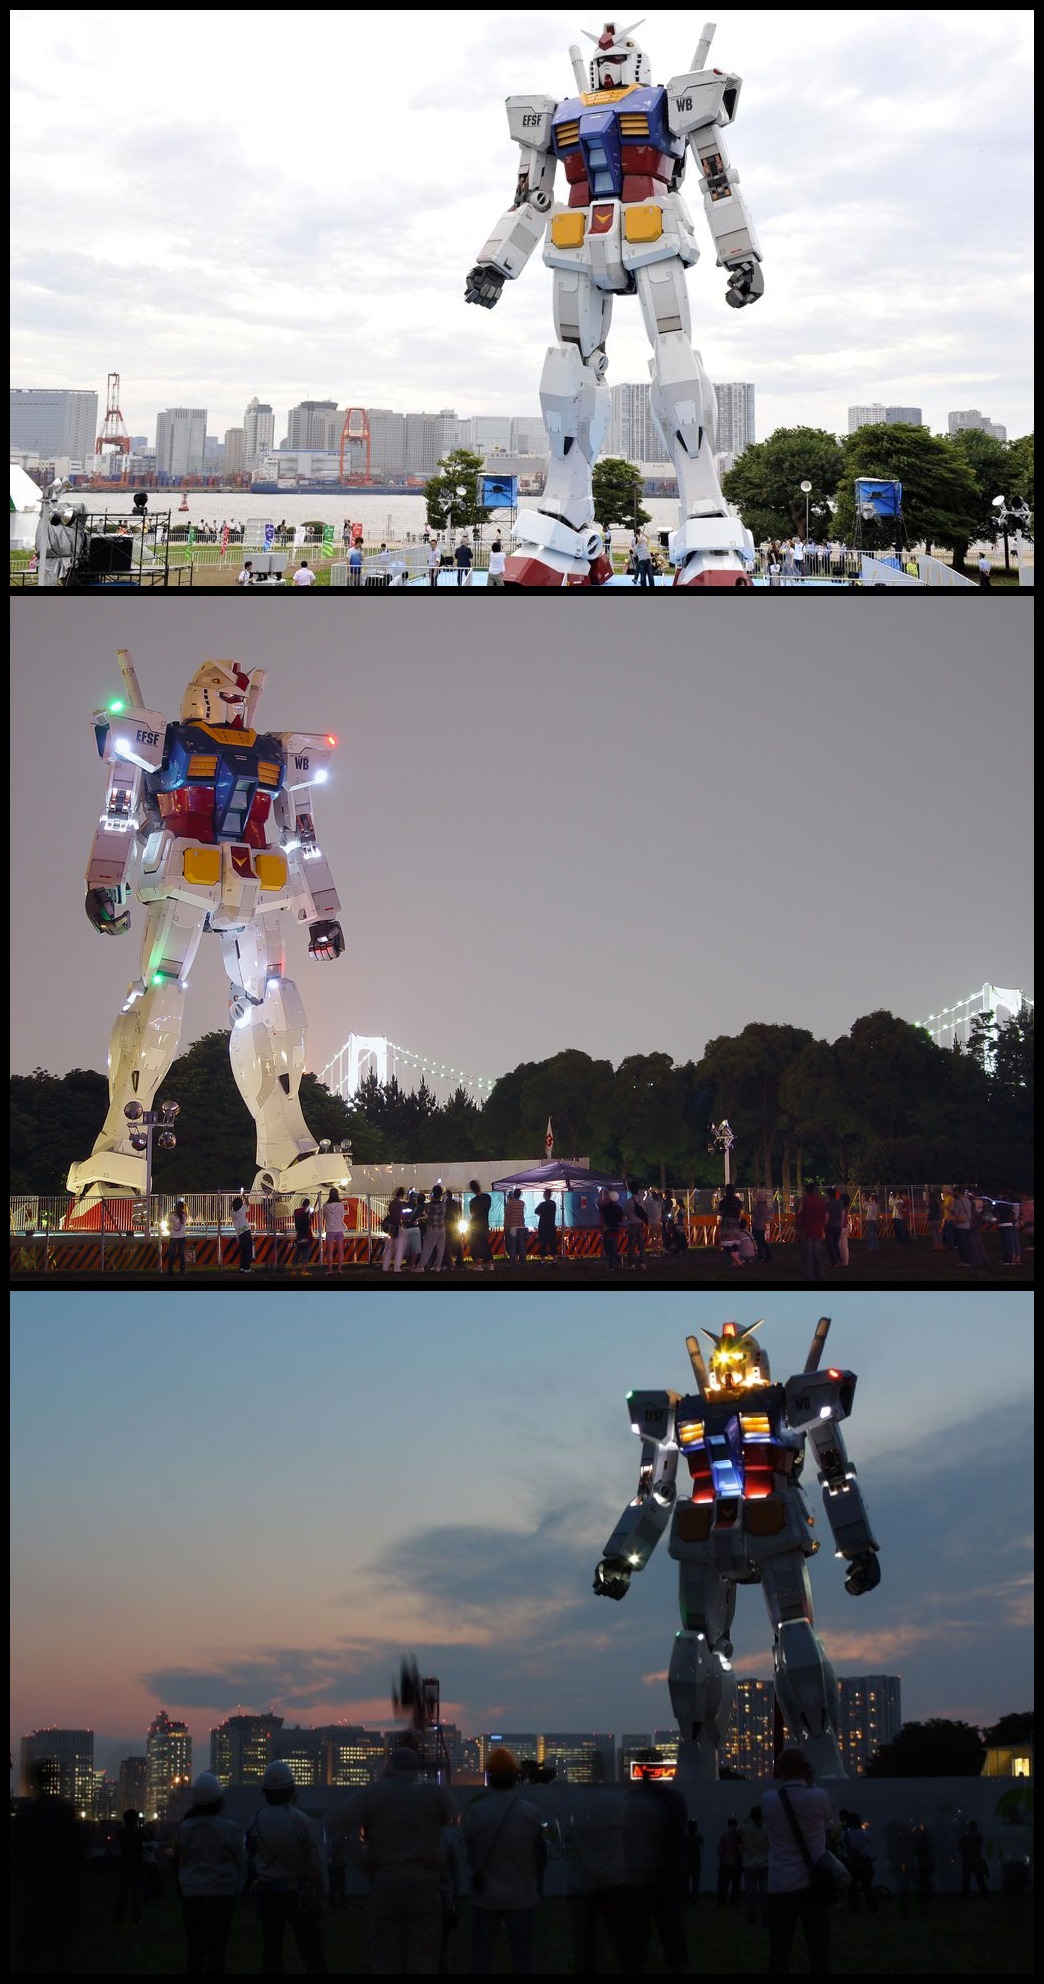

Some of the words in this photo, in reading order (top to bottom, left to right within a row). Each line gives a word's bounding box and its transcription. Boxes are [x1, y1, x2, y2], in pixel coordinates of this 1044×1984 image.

[676, 98, 693, 112] WB
[522, 114, 543, 126] EFSF
[136, 729, 160, 746] EFSF
[295, 757, 309, 771] WB
[795, 1397, 810, 1411] WB
